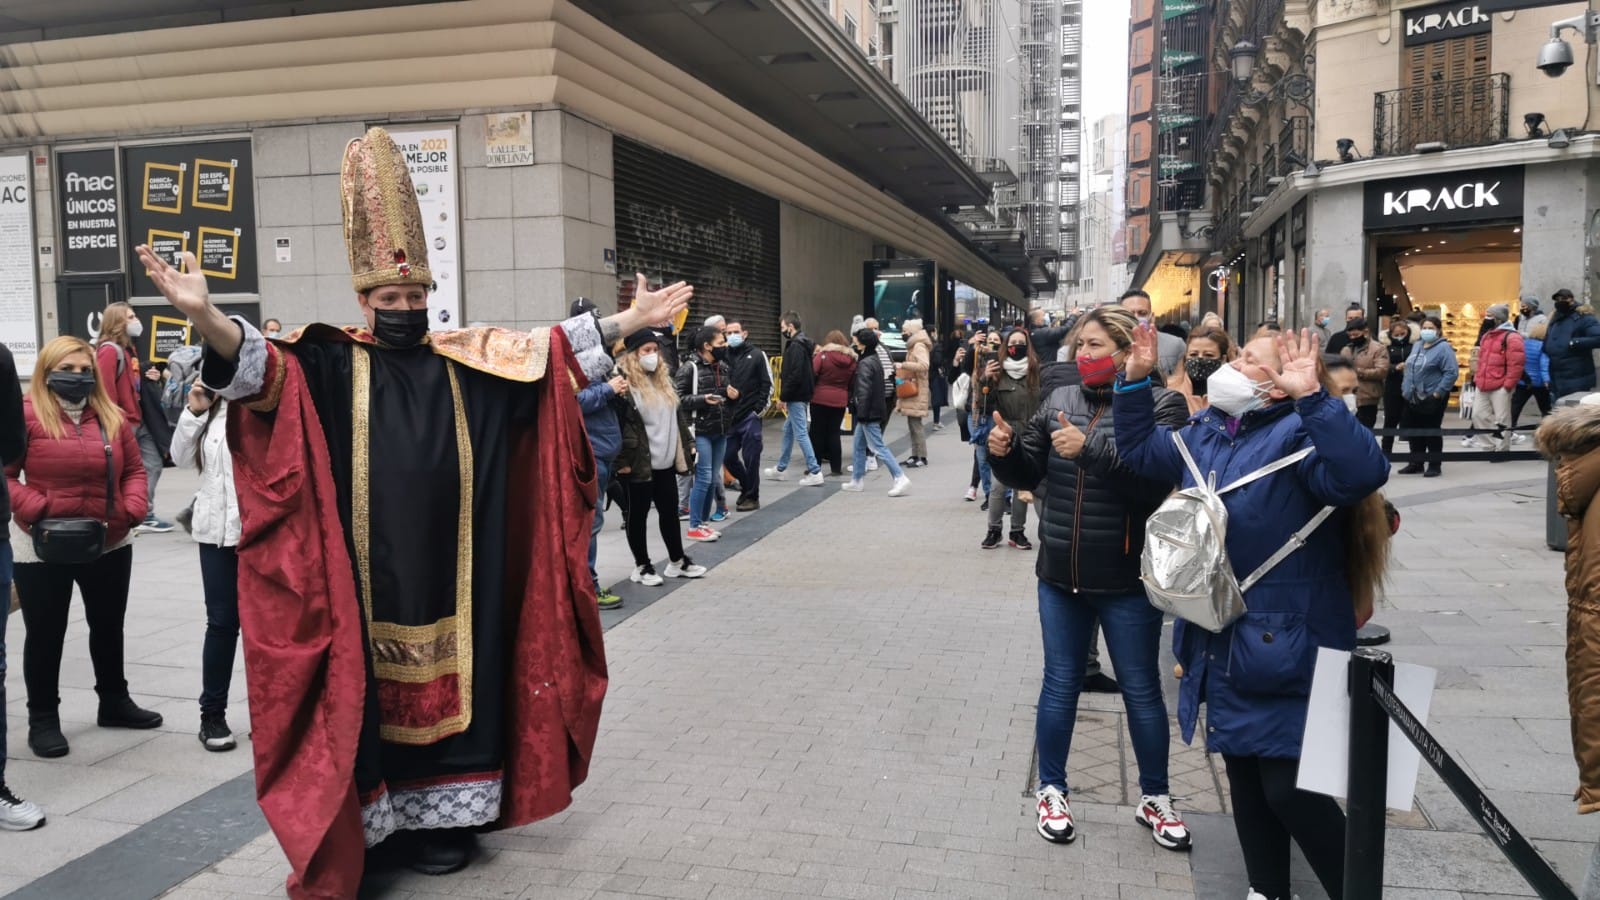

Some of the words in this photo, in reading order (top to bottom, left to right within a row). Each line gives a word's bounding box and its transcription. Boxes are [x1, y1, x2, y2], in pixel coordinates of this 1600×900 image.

[1407, 6, 1490, 36] KRACK
[408, 143, 419, 152] EN
[420, 138, 448, 151] 2021
[406, 151, 448, 163] MEJOR
[416, 165, 449, 173] POSIBLE
[65, 172, 115, 193] fnac
[66, 197, 116, 214] ÚNICOS
[1383, 181, 1501, 216] KRACK
[67, 220, 78, 230] EN
[79, 218, 116, 229] NUESTRA
[68, 234, 117, 249] ESPECIE
